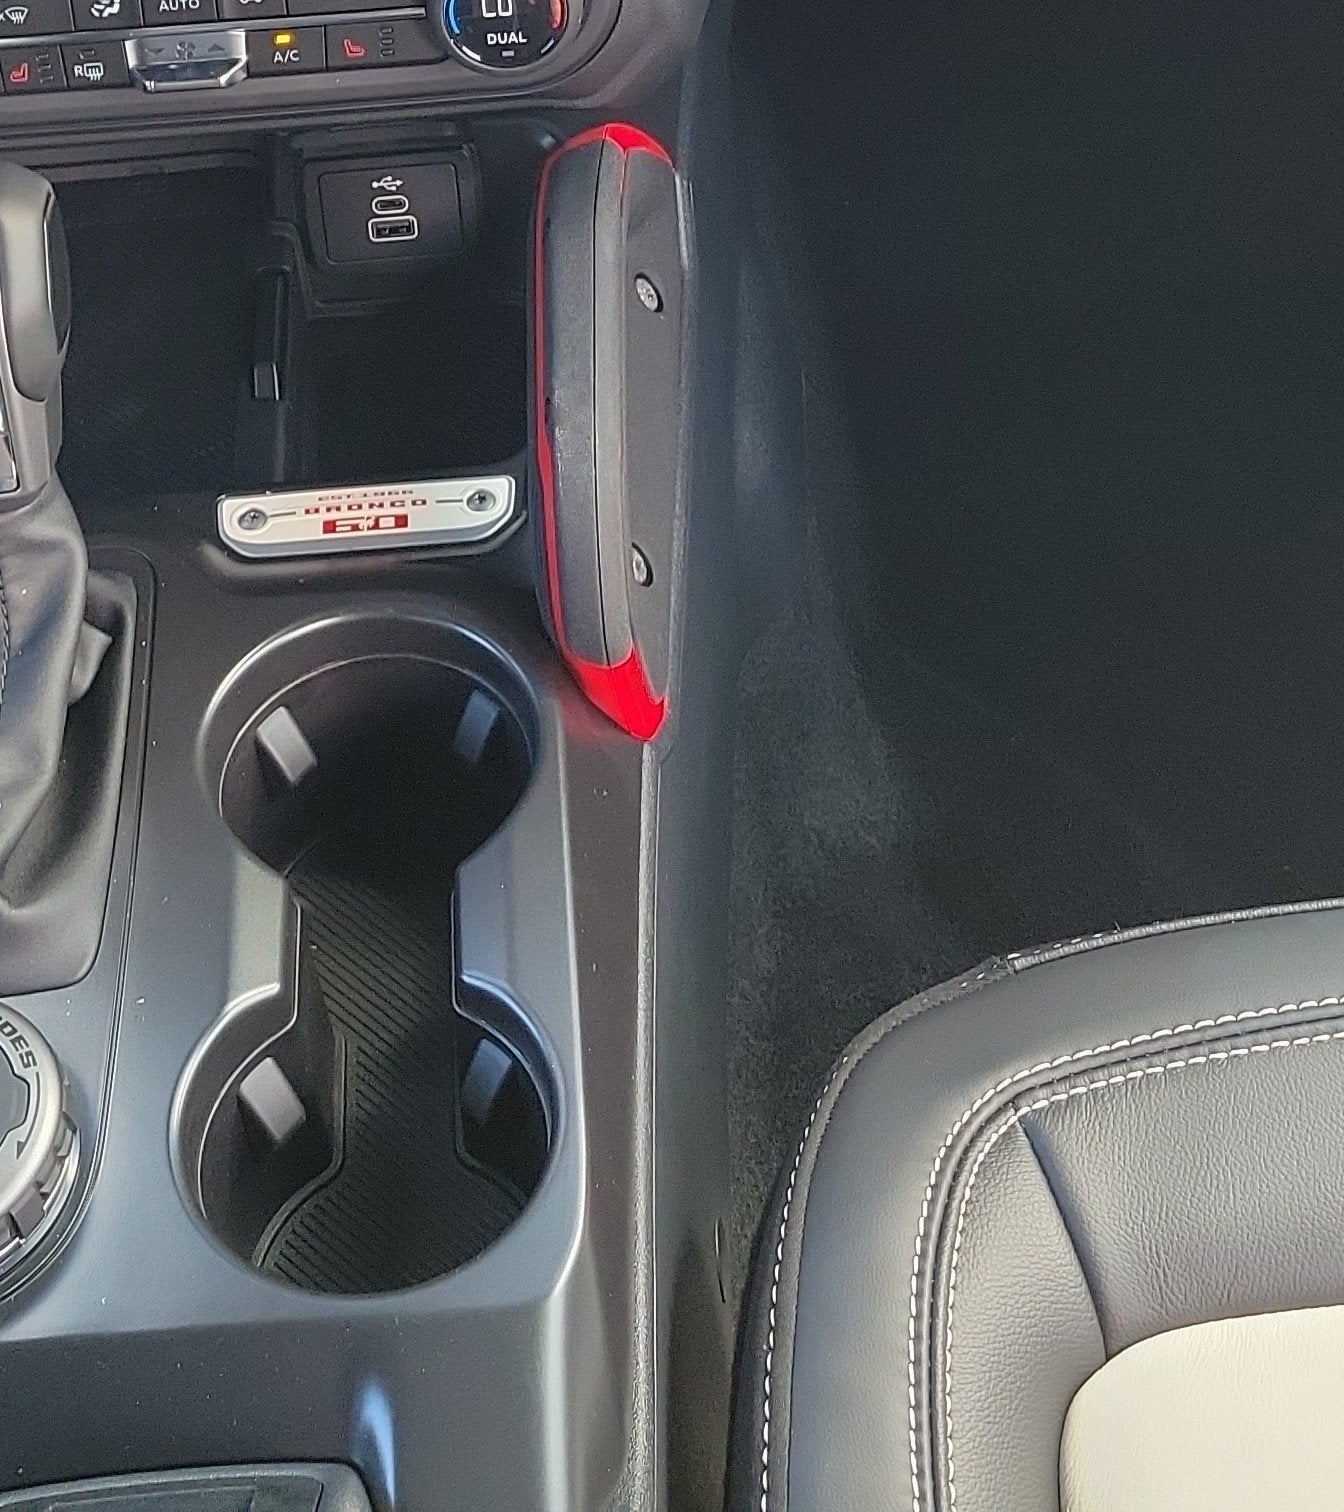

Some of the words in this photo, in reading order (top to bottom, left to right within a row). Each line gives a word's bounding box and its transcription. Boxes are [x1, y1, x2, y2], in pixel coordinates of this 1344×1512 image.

[486, 30, 528, 46] DUAL
[273, 49, 300, 64] A/C
[74, 66, 84, 78] R
[304, 499, 427, 515] BRONCO
